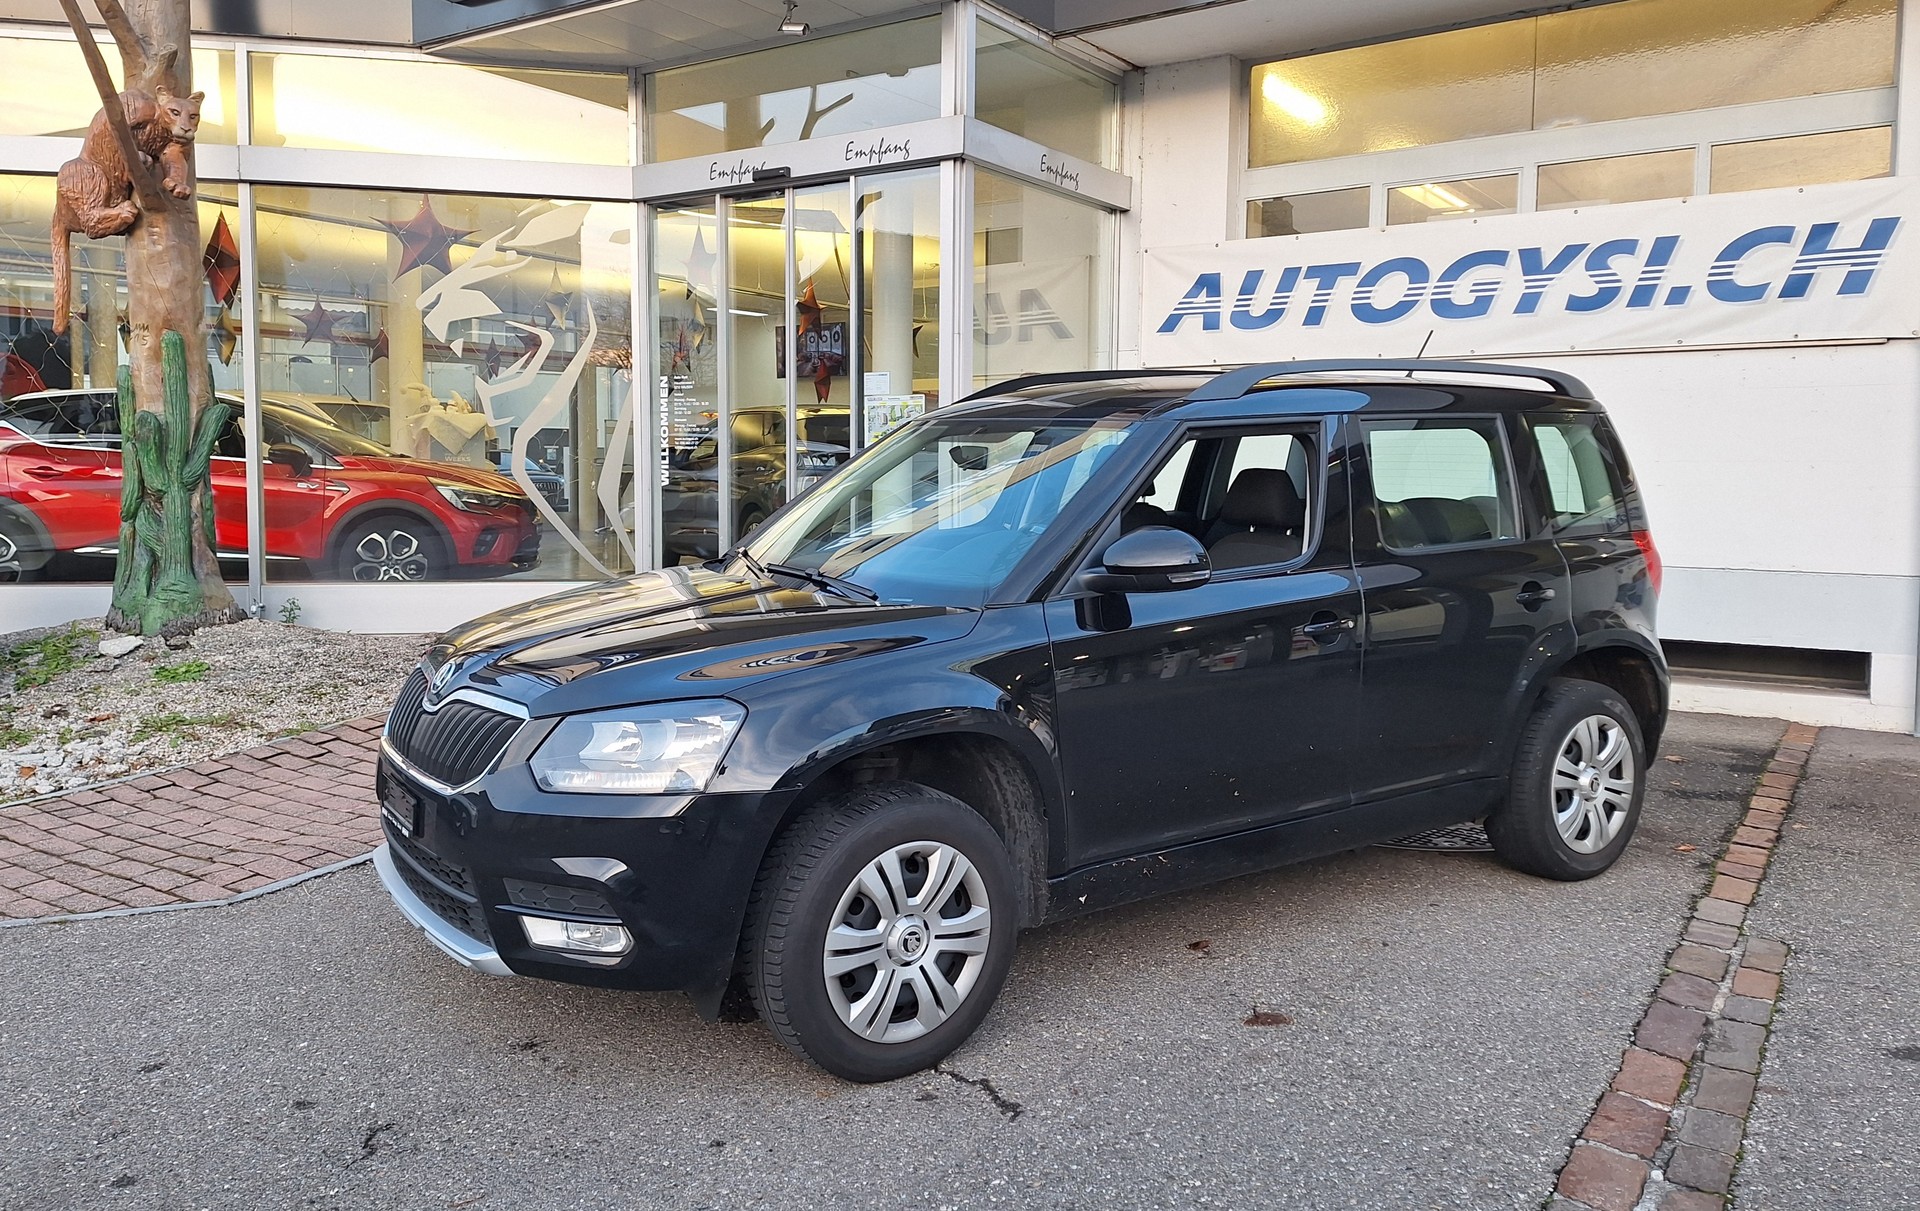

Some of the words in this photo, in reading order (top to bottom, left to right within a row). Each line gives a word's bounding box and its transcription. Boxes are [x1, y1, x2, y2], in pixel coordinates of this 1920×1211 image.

[845, 137, 910, 164] Empfang
[1040, 154, 1079, 191] Empfang
[1156, 215, 1902, 334] AUTOGYSI.CH
[660, 375, 670, 487] WILLKOMMEN
